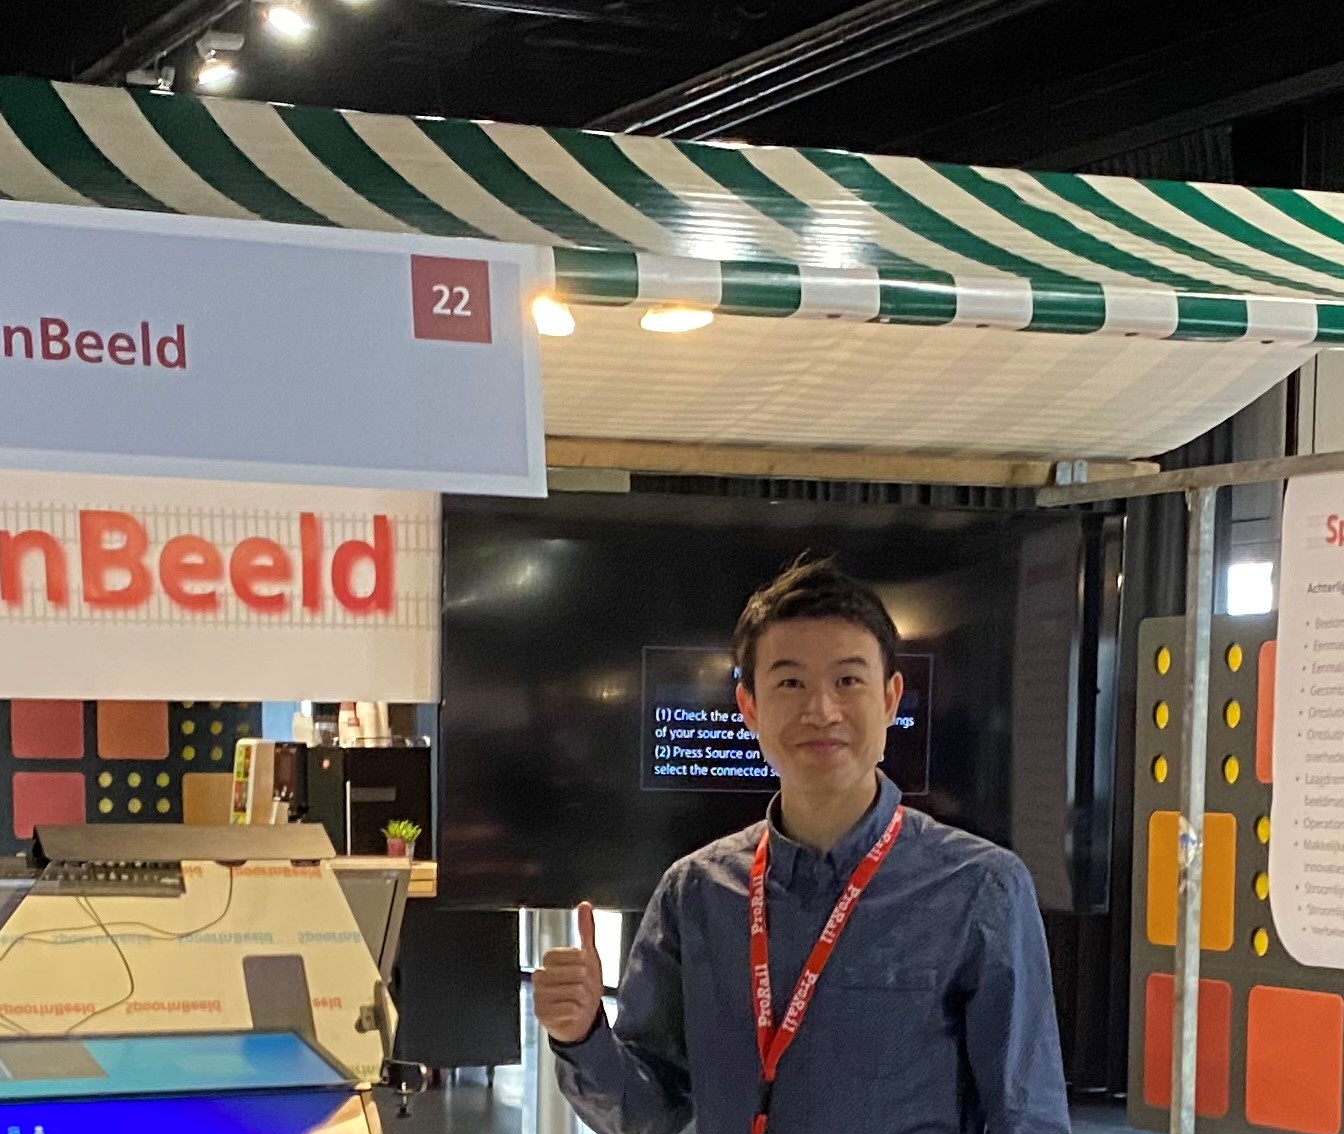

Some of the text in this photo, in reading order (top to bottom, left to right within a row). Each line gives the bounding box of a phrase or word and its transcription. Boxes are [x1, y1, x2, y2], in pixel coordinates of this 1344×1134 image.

[432, 285, 472, 317] 22
[655, 707, 672, 723] (1)
[673, 709, 708, 722] Check
[710, 710, 729, 723] the
[655, 725, 668, 739] of
[669, 728, 696, 741] your
[697, 728, 735, 740] source
[654, 744, 761, 760] (2) Press Source on
[654, 763, 688, 776] select
[689, 763, 709, 776] the
[710, 764, 769, 777] connected
[750, 874, 765, 937] ProRail
[819, 882, 862, 945] ProRail
[755, 963, 772, 1029] ProRail
[781, 968, 820, 1034] ProRail
